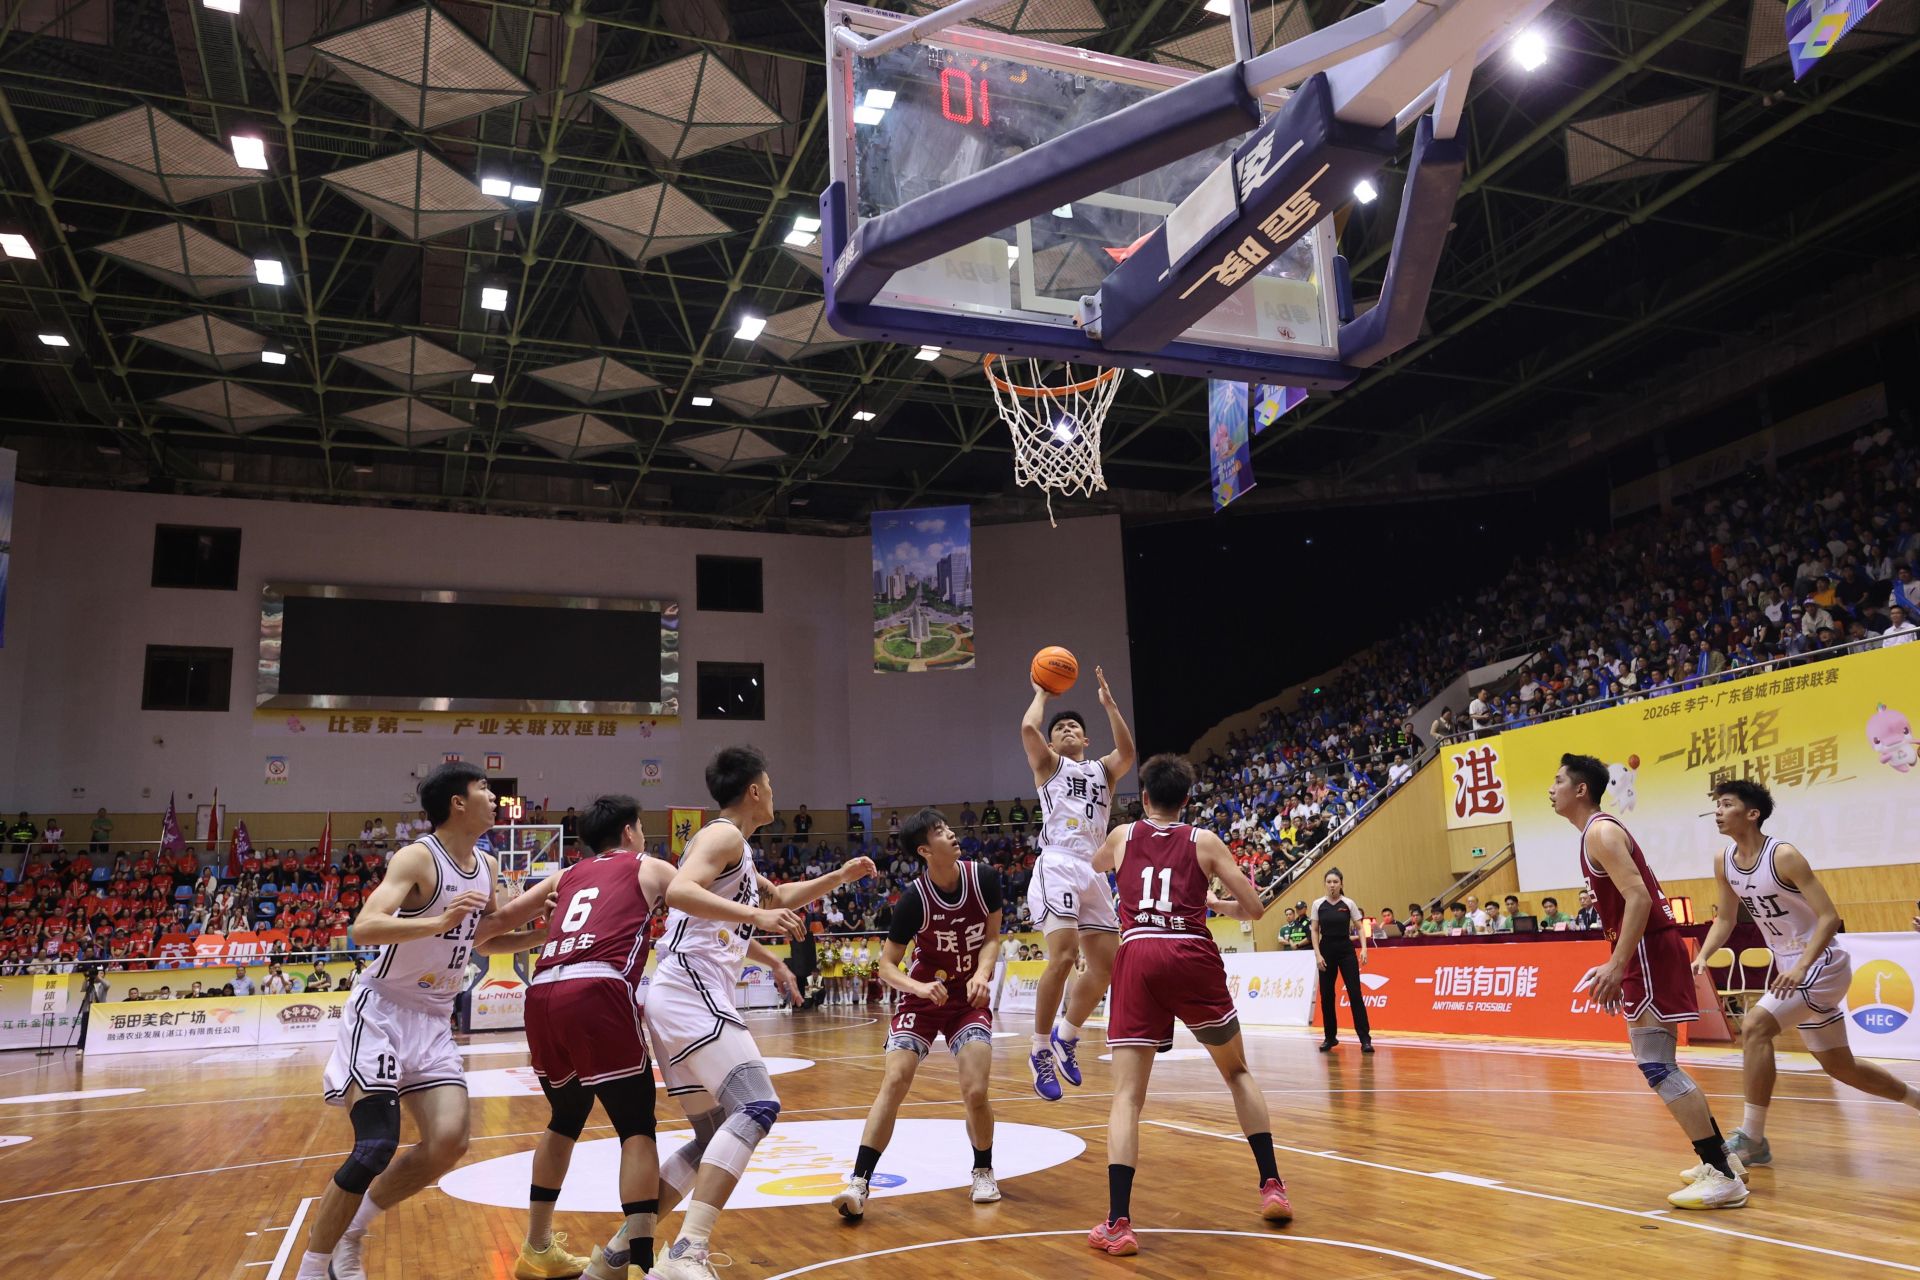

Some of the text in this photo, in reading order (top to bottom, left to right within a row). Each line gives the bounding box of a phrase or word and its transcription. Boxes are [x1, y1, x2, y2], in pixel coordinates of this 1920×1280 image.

[1643, 667, 1840, 720] 2026年 李宁·广东省城市篮球联赛
[328, 716, 618, 736] 比赛第二 产业关联双延链
[1655, 706, 1784, 771] 一战城名
[1067, 776, 1107, 808] 湛江
[1453, 747, 1505, 818] 湛
[509, 805, 521, 819] 10
[1085, 804, 1094, 819] 0
[1139, 867, 1173, 912] 11
[560, 887, 600, 933] 6
[1063, 893, 1073, 909] 0
[934, 922, 985, 953] 茂名
[1763, 922, 1783, 936] 11
[541, 933, 597, 960] 黄金生
[447, 946, 466, 969] 12
[956, 954, 972, 972] 13
[1414, 966, 1539, 997] 一切皆有可能
[43, 980, 56, 1011] 媒体区
[478, 991, 522, 1000] LI-NING
[1432, 1000, 1512, 1013] ANYTHING IS POSSIBLE
[109, 1010, 207, 1030] 海田美食广场
[896, 1012, 916, 1029] 13
[1866, 1014, 1894, 1026] HEC
[107, 1026, 241, 1042] 融通农业发展(湛江)有限责任公司
[376, 1053, 398, 1080] 12
